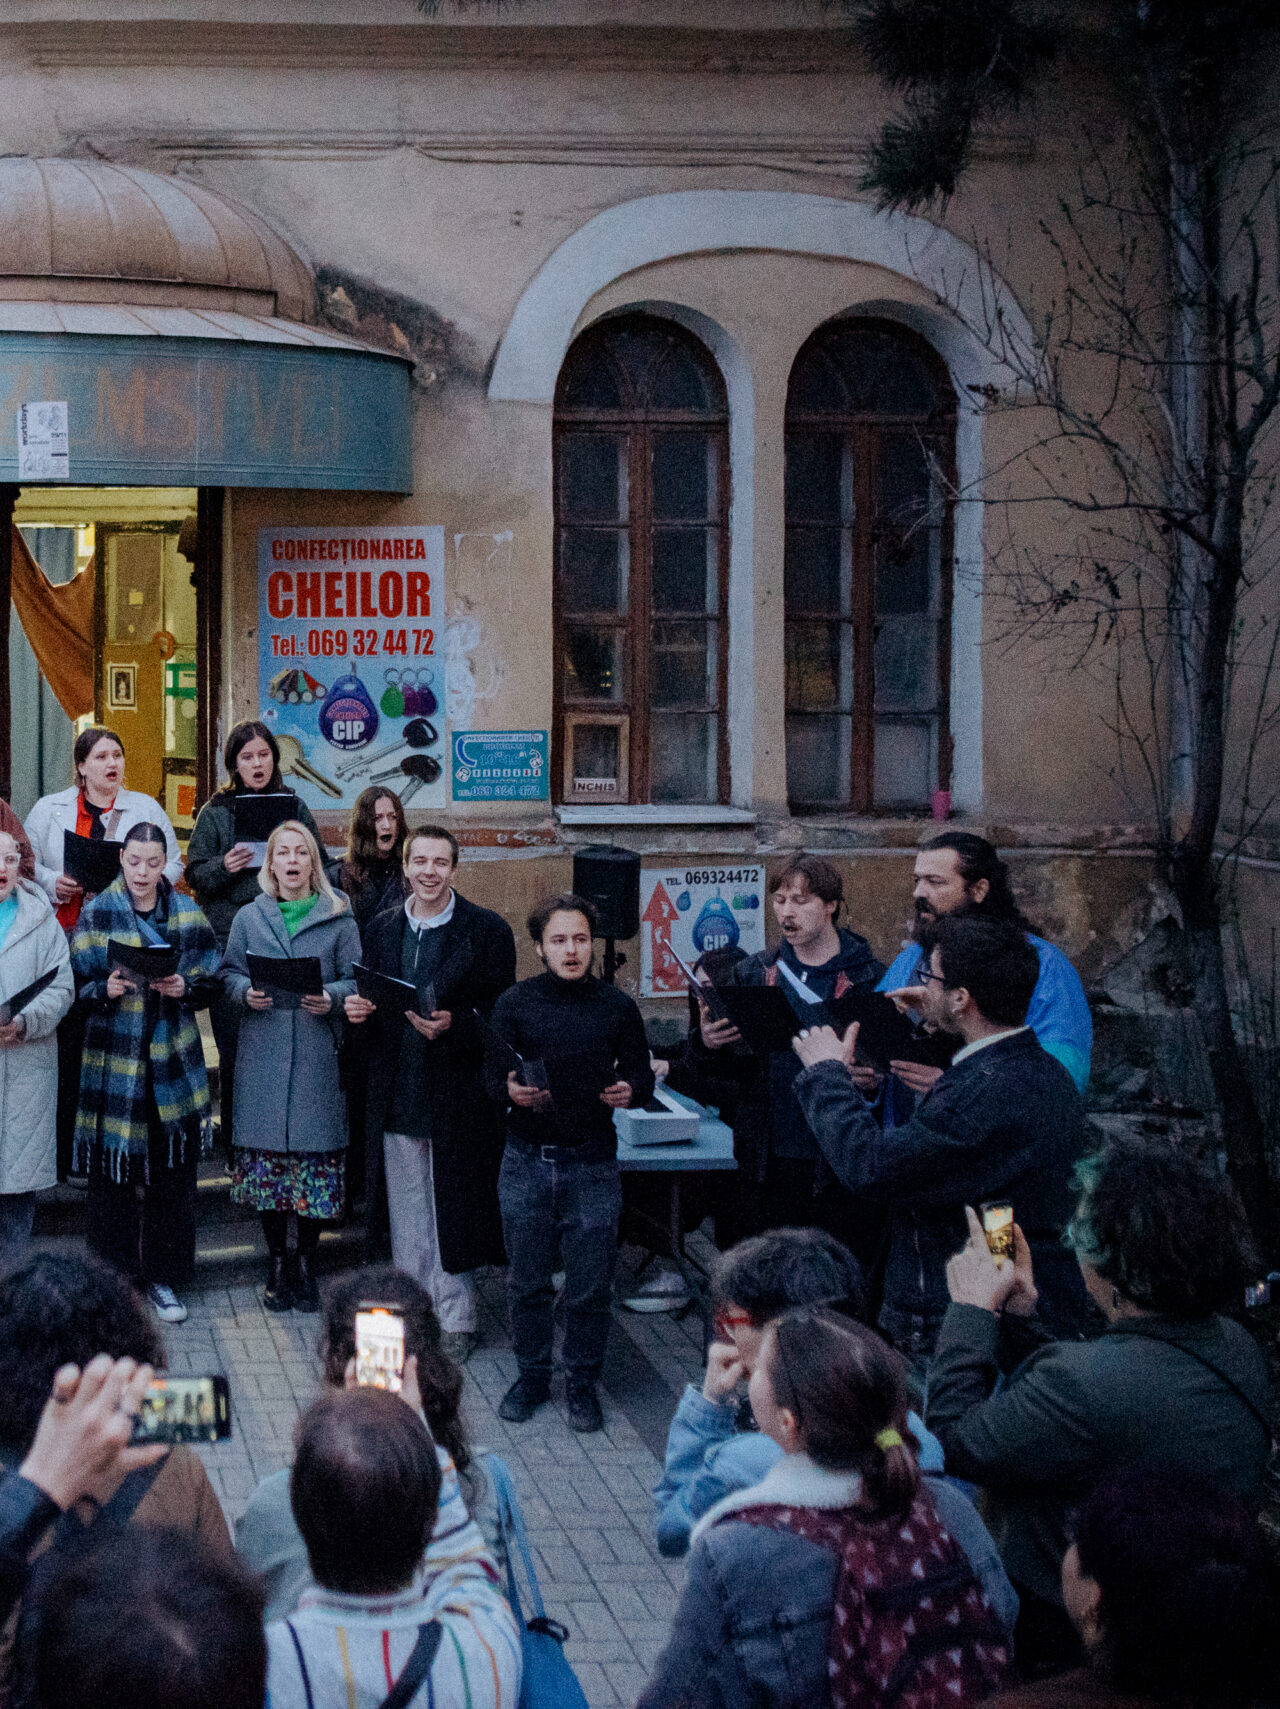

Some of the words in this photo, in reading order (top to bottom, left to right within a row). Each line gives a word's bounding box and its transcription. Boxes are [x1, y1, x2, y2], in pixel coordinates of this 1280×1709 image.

[271, 538, 427, 565] CONFECȚIONAREA
[268, 570, 431, 619] CHEILOR
[271, 634, 305, 657] Tel.:
[308, 629, 348, 657] 069
[353, 629, 379, 657] 32
[383, 628, 408, 656] 44
[411, 628, 435, 656] 72
[332, 720, 365, 741] CIP
[685, 869, 759, 885] 069324472
